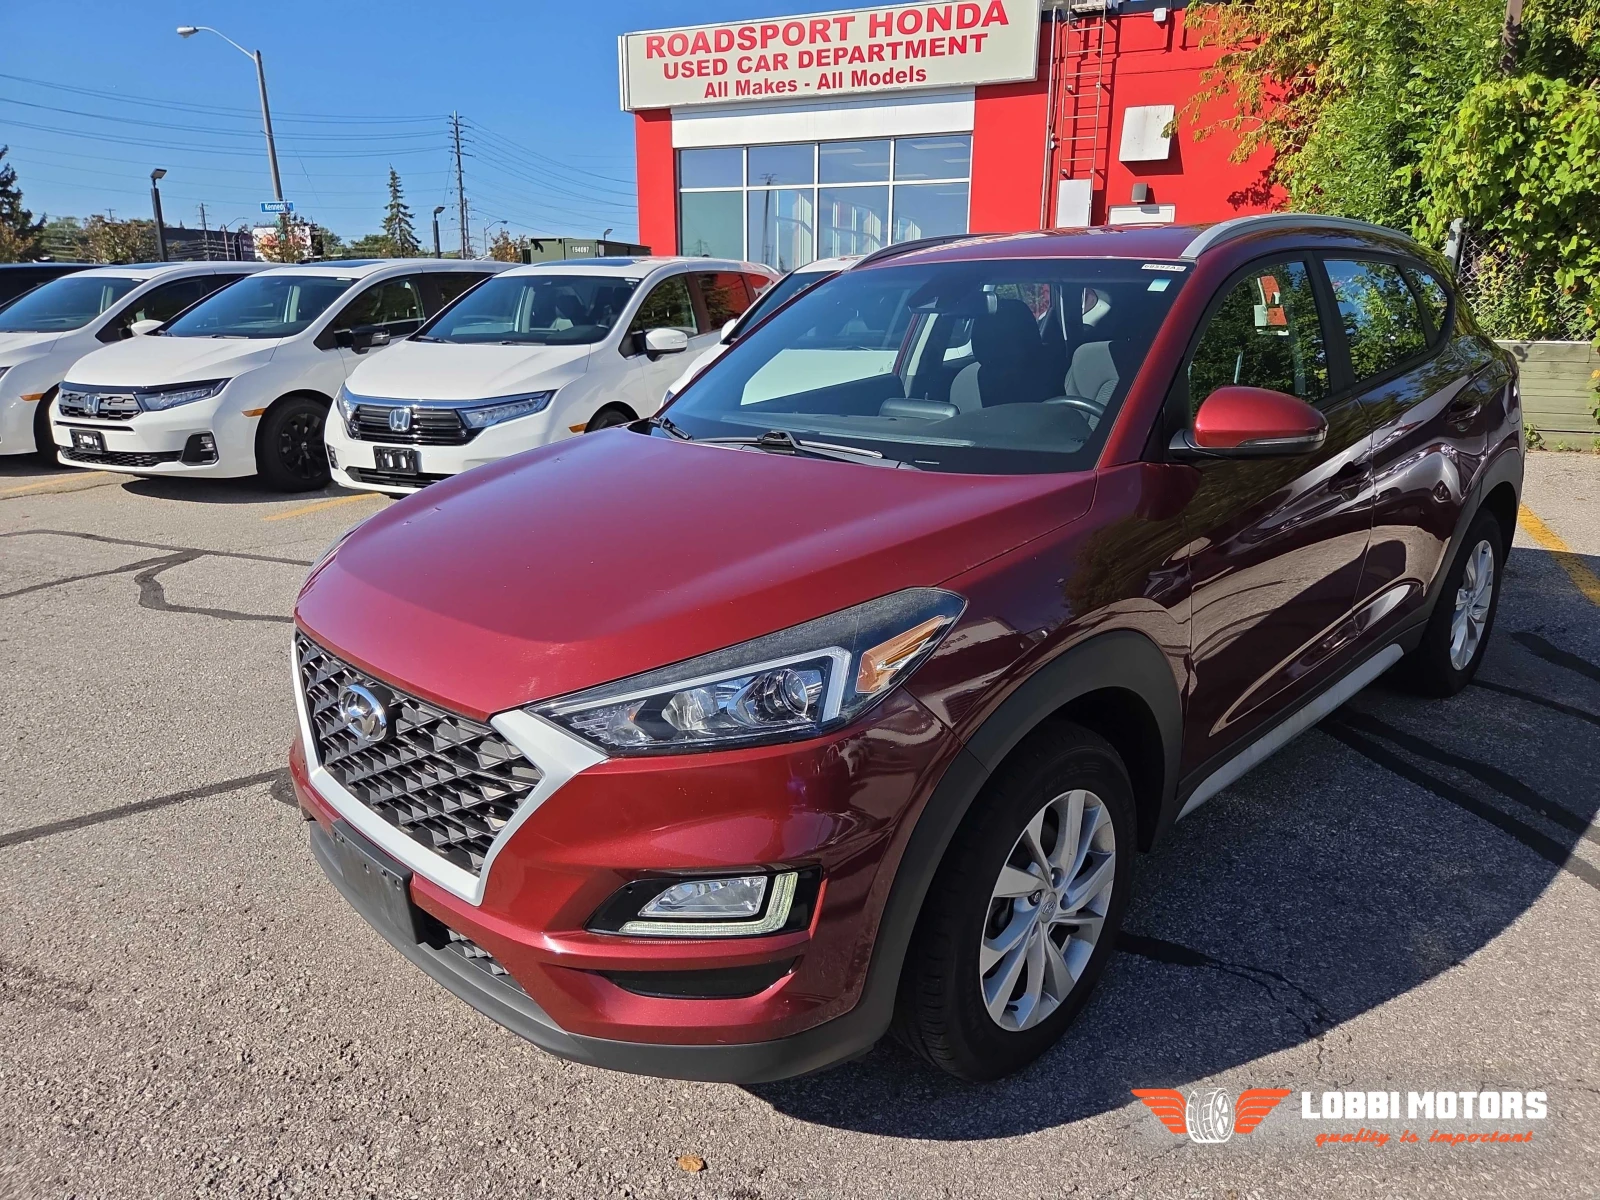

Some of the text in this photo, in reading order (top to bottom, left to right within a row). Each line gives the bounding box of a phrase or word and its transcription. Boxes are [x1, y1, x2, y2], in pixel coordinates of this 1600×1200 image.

[645, 0, 1009, 60] ROADSPORT HONDA
[663, 32, 989, 80] USED CAR DEPARTMENT
[704, 81, 729, 98] All
[735, 78, 798, 97] Makes
[817, 71, 843, 90] All
[850, 65, 927, 88] Models
